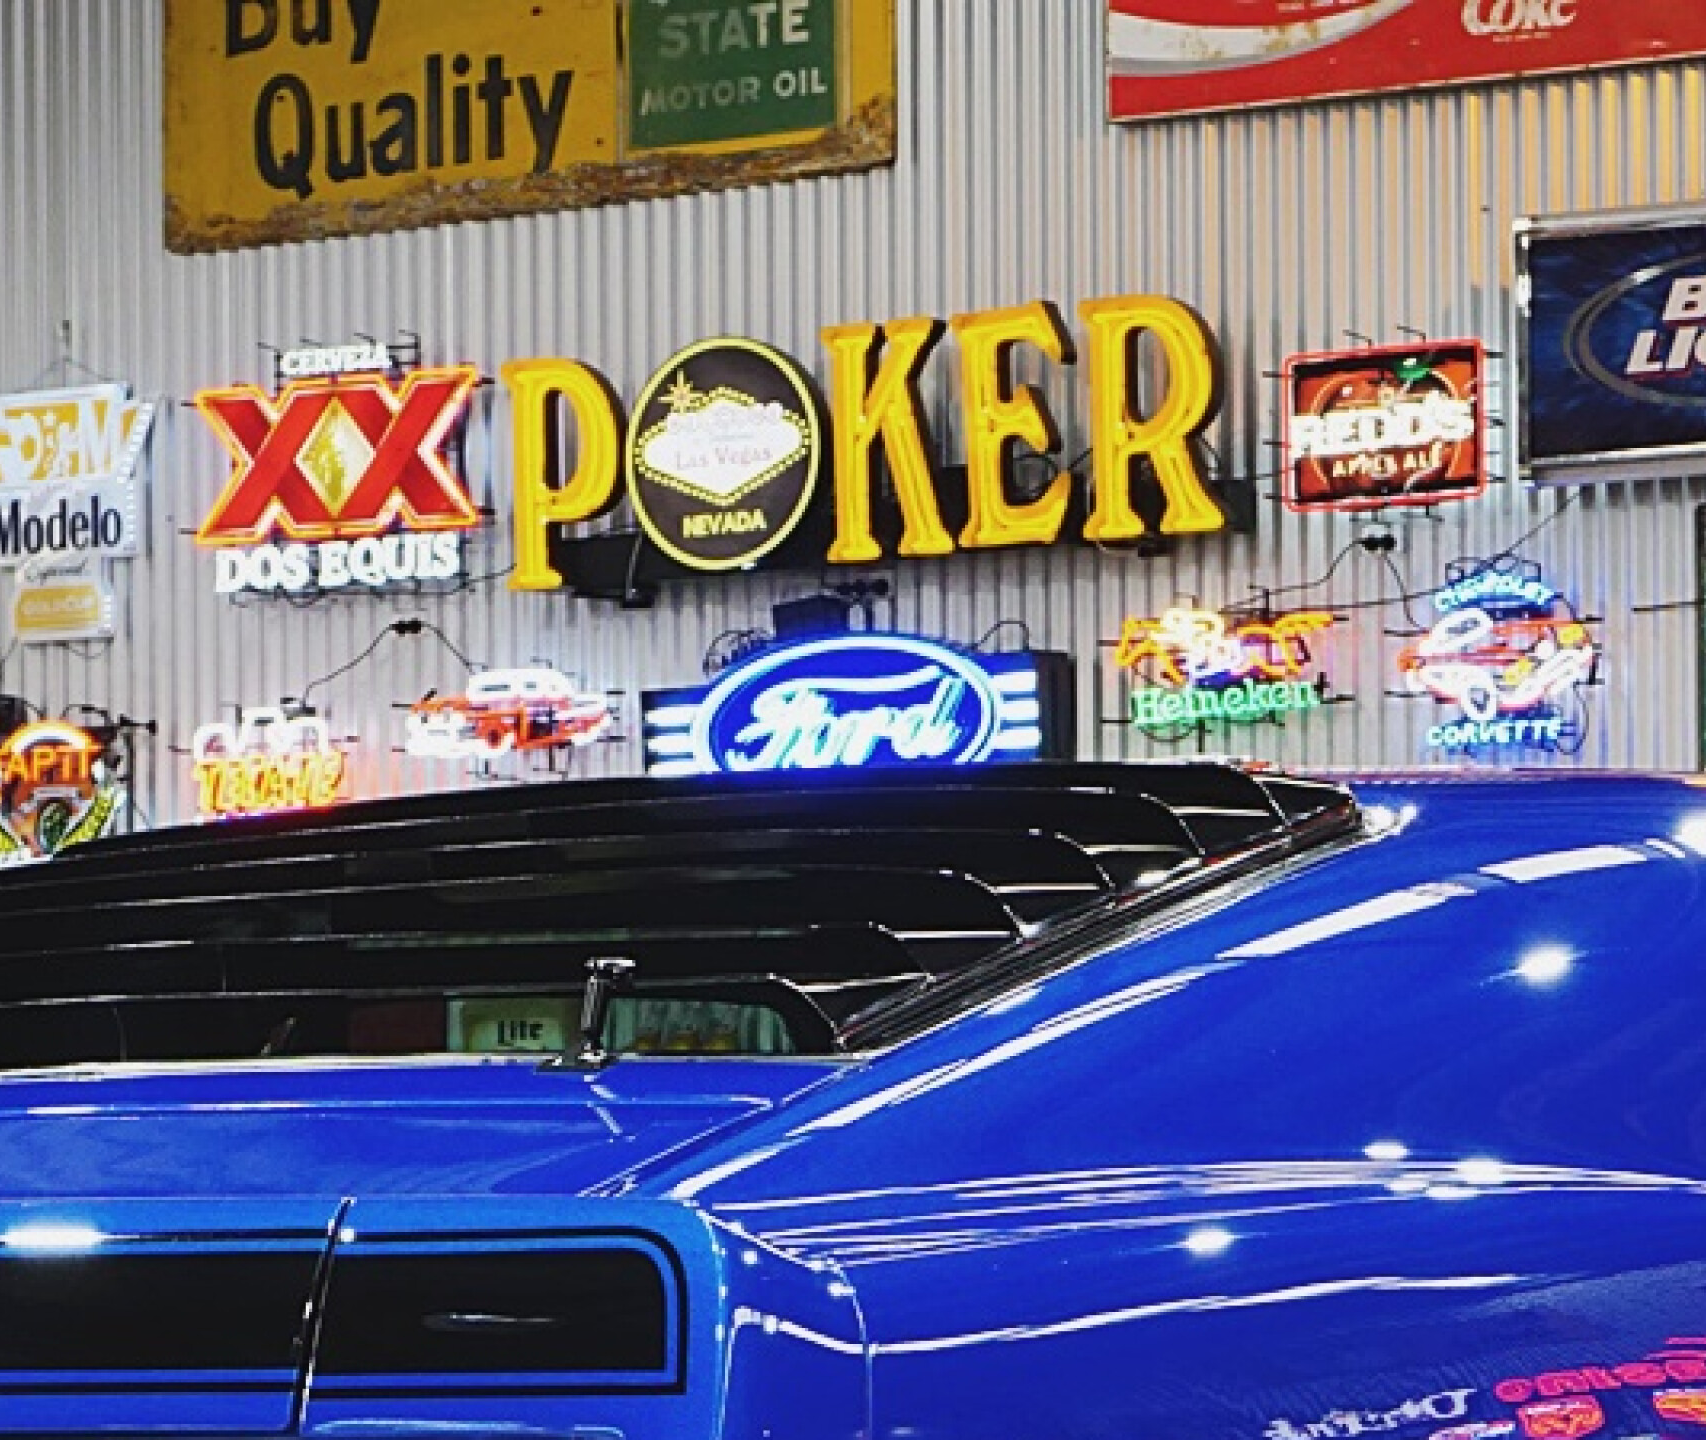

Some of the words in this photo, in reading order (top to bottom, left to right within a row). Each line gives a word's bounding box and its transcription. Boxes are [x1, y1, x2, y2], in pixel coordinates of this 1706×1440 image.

[225, 0, 380, 64] Buy
[658, 4, 814, 60] STATE
[640, 83, 761, 118] MOTOR
[773, 67, 826, 98] OIL
[255, 53, 575, 199] Quality
[682, 509, 768, 538] NEVADA
[215, 542, 310, 593] DOS
[318, 530, 461, 586] EQUIS
[723, 662, 964, 767] Ford
[1131, 678, 1323, 725] Heineken
[1426, 718, 1566, 747] CORVETTE
[496, 1019, 545, 1046] Lite
